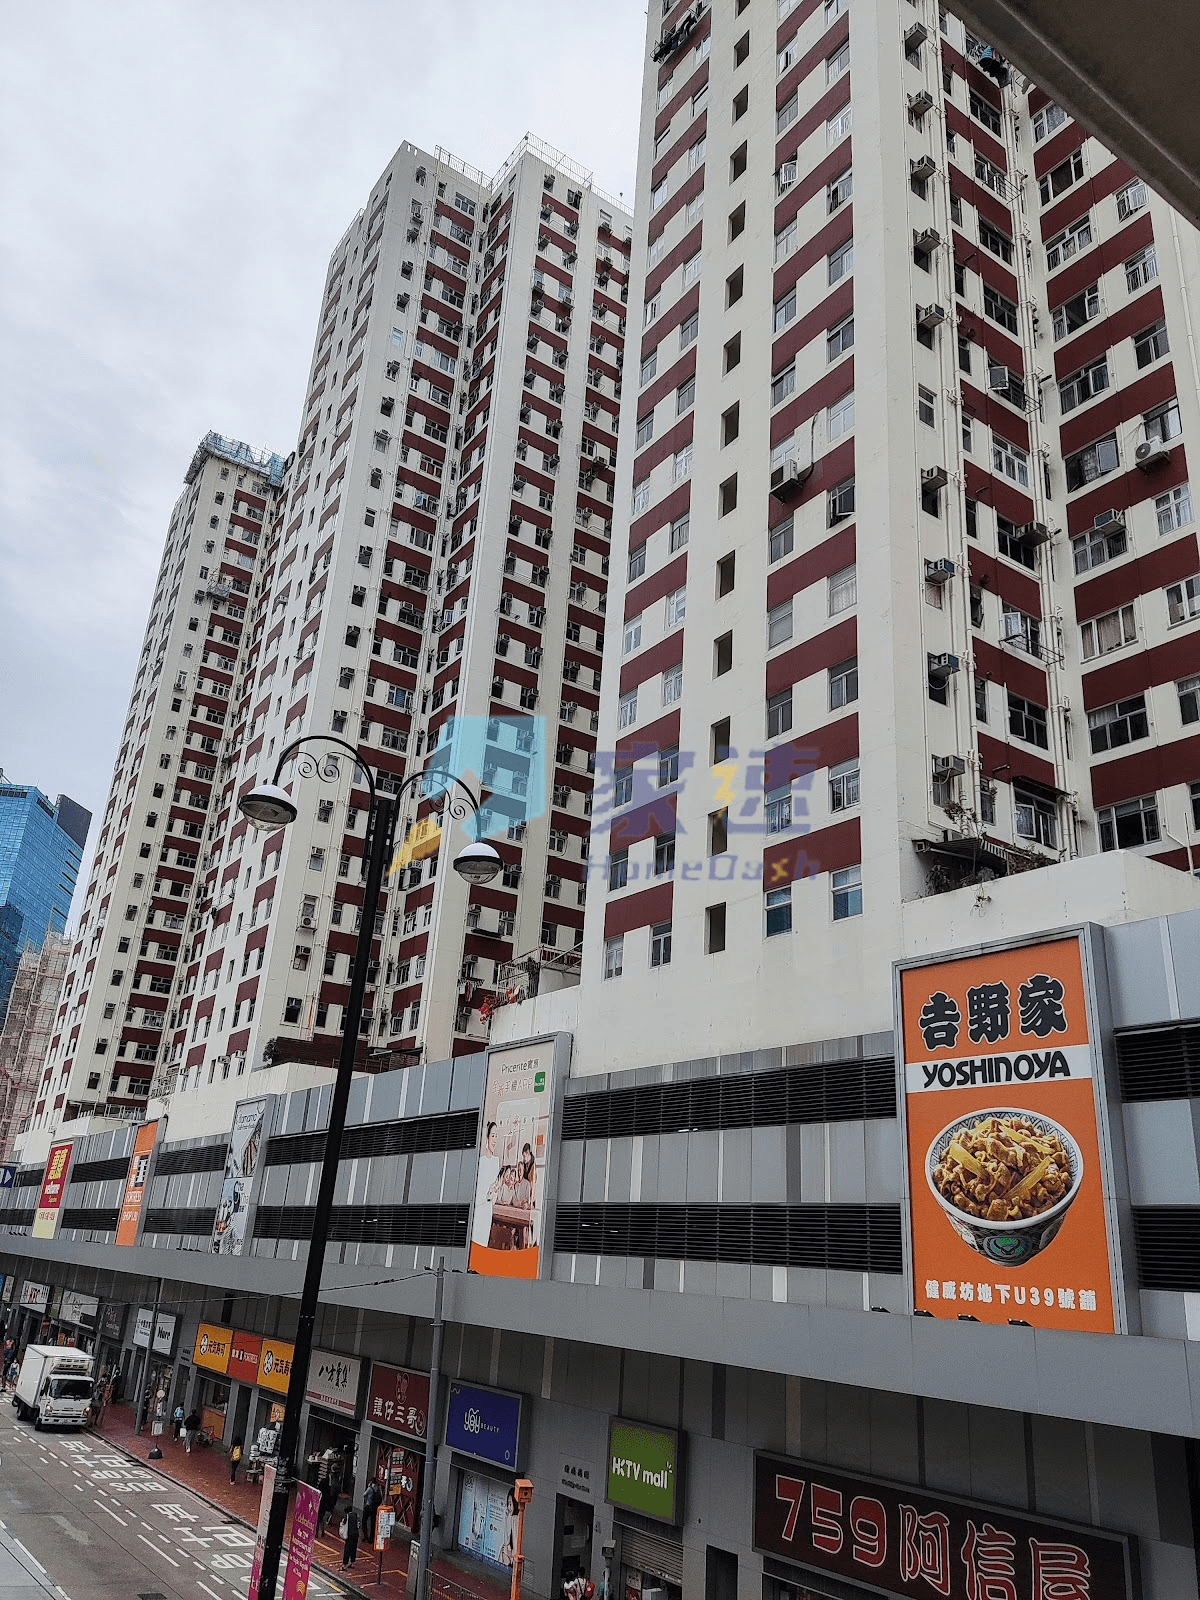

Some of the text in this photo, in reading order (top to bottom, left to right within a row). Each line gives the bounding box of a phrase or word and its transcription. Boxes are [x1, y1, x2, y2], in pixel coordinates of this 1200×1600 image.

[919, 974, 1068, 1051] 吉野家
[922, 1051, 1071, 1089] YOSHINOYA
[373, 1397, 417, 1429] 譚仔三哥
[91, 1470, 153, 1479] STOP
[109, 1482, 168, 1492] BUS
